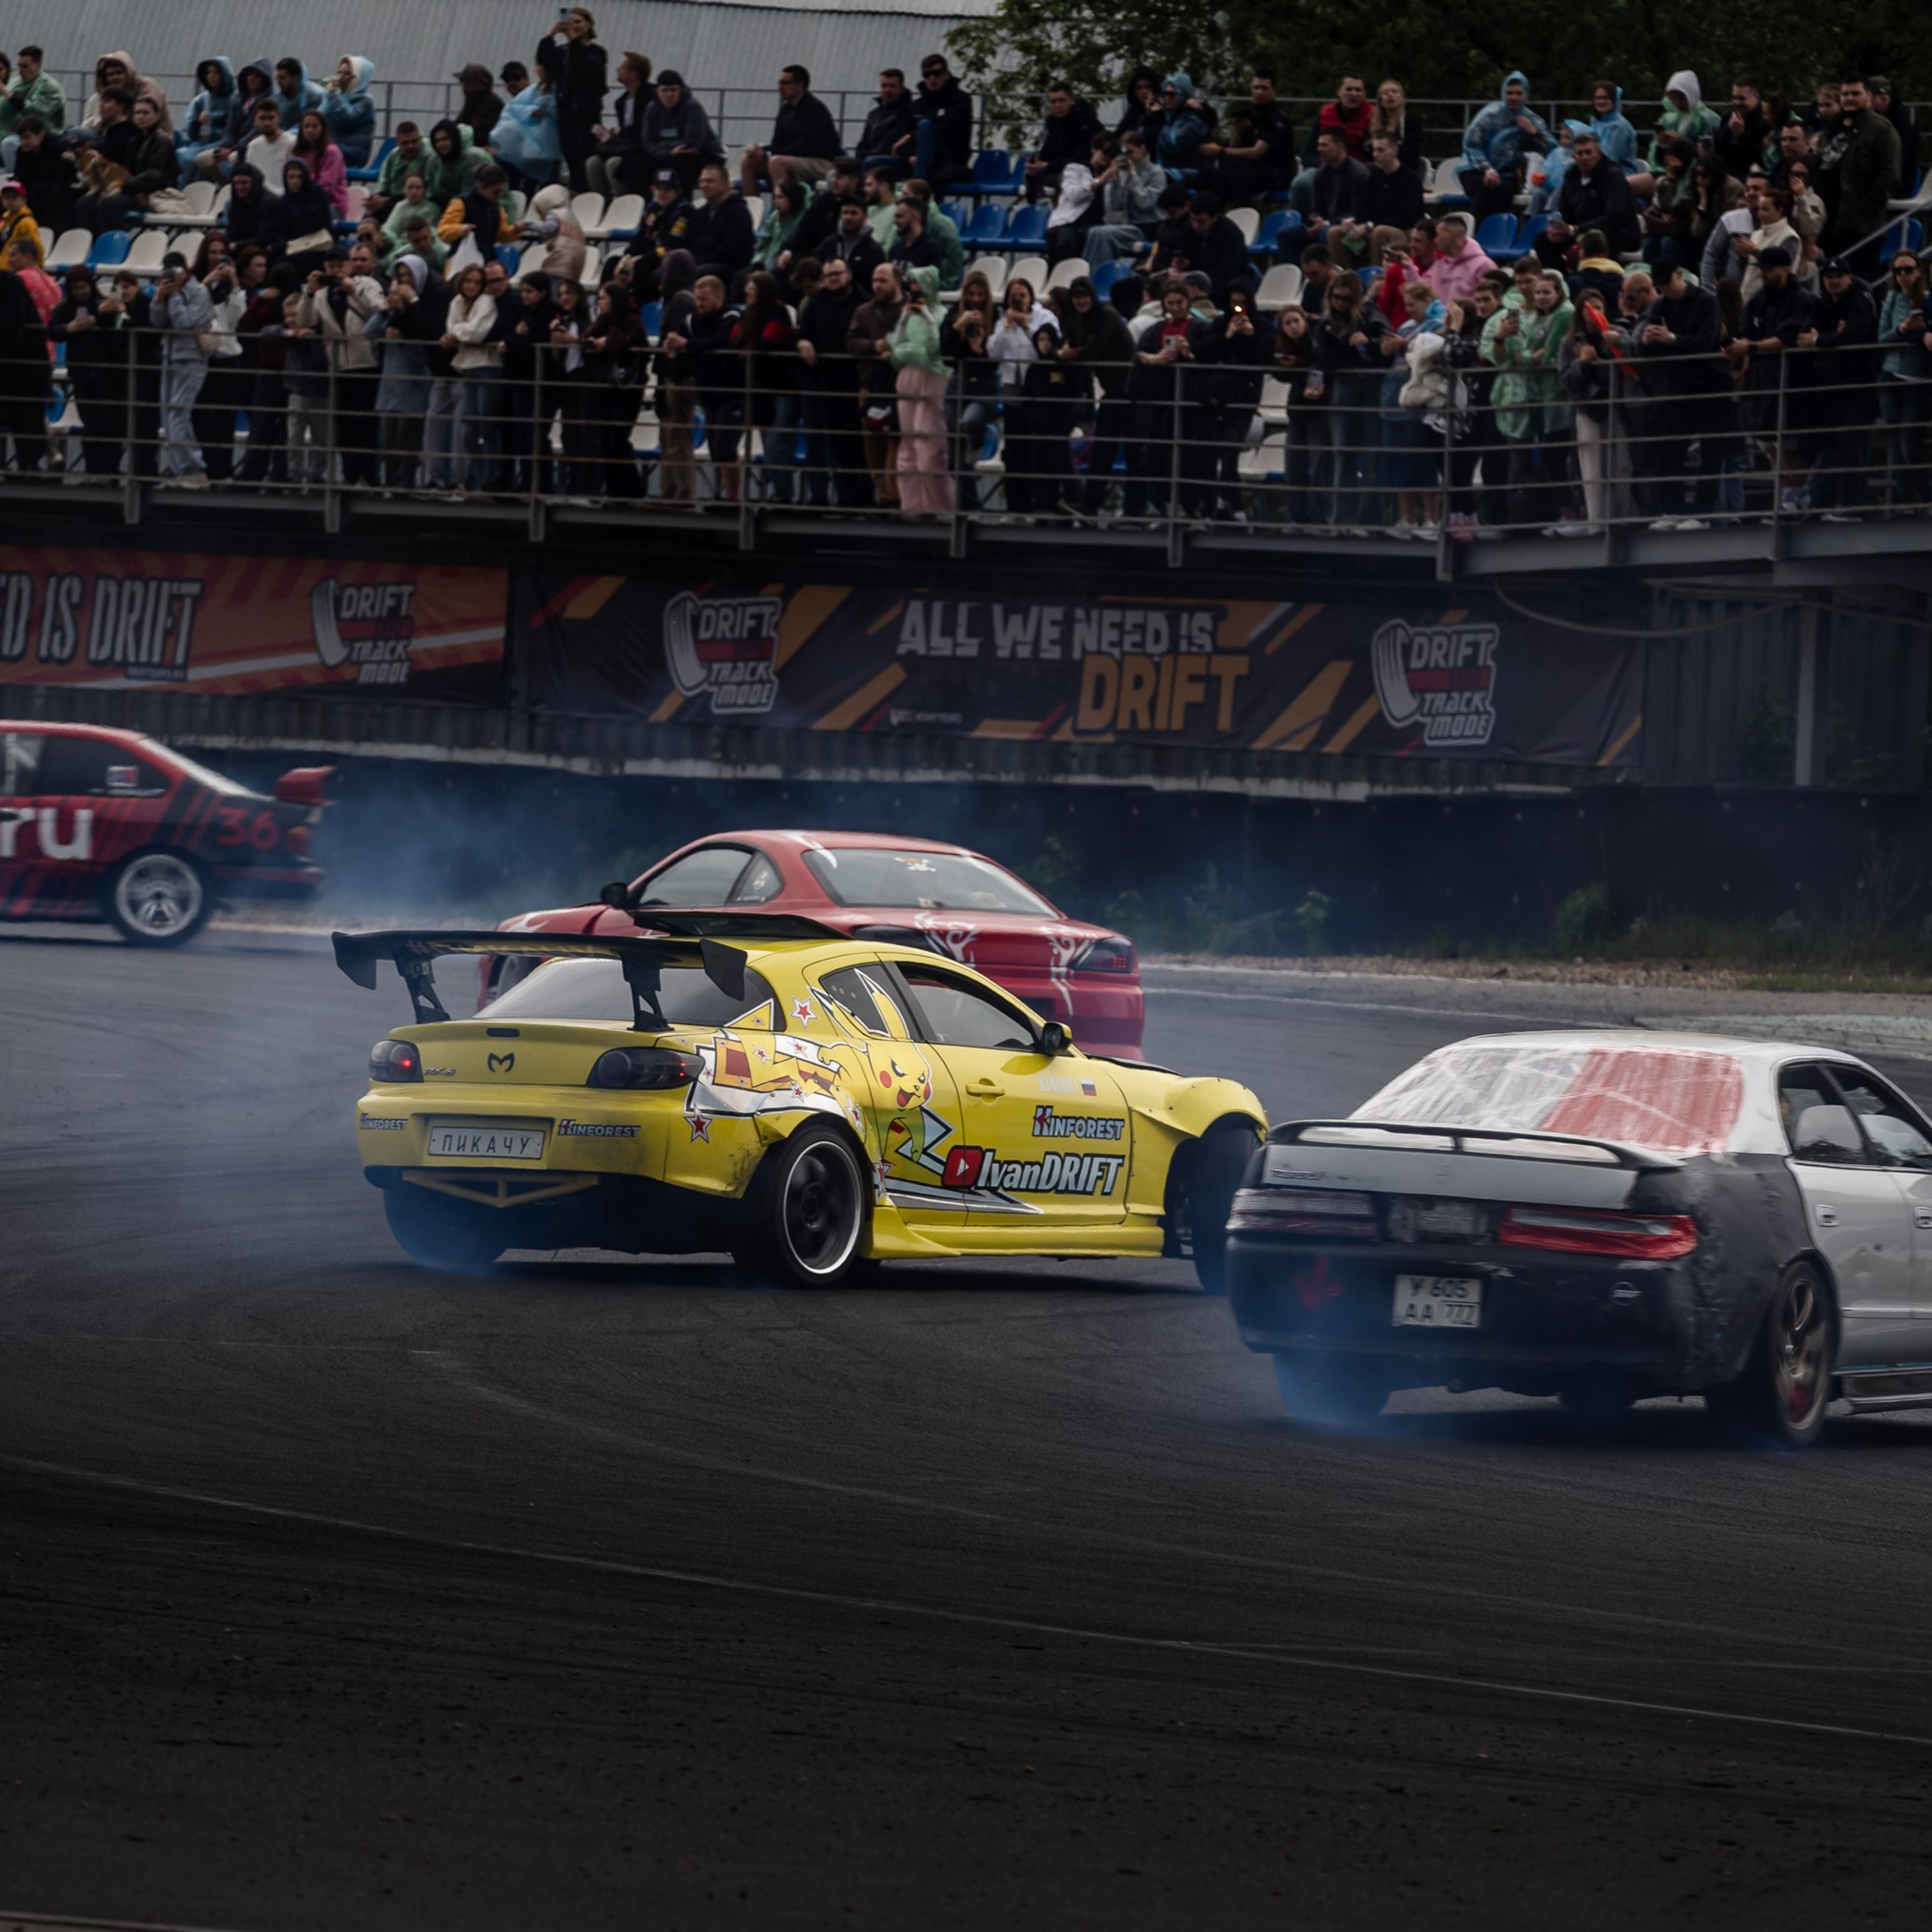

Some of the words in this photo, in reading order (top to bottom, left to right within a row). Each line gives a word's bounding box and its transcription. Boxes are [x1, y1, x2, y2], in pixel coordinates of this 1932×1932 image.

[340, 584, 414, 617] DRIFT
[38, 574, 82, 659] IS
[89, 577, 202, 666] DRIFT
[699, 605, 776, 639] DRIFT
[897, 600, 979, 657] ALL
[992, 605, 1062, 660] WE
[1072, 607, 1169, 661] NEED
[1180, 611, 1214, 653] IS
[349, 640, 408, 662] TRACK
[1410, 632, 1494, 669] DRIFT
[358, 663, 411, 684] MODE
[709, 661, 772, 682] TRACK
[716, 682, 774, 706] MODE
[1077, 654, 1250, 731] DRIFT
[1422, 692, 1490, 714] TRACK
[1433, 714, 1490, 737] MODE
[217, 806, 280, 850] 36
[558, 1119, 641, 1137] KINFOREST
[1032, 1106, 1124, 1140] KINFOREST
[441, 1133, 530, 1155] ПИКАЧУ
[977, 1149, 1125, 1195] IvanDRIFT
